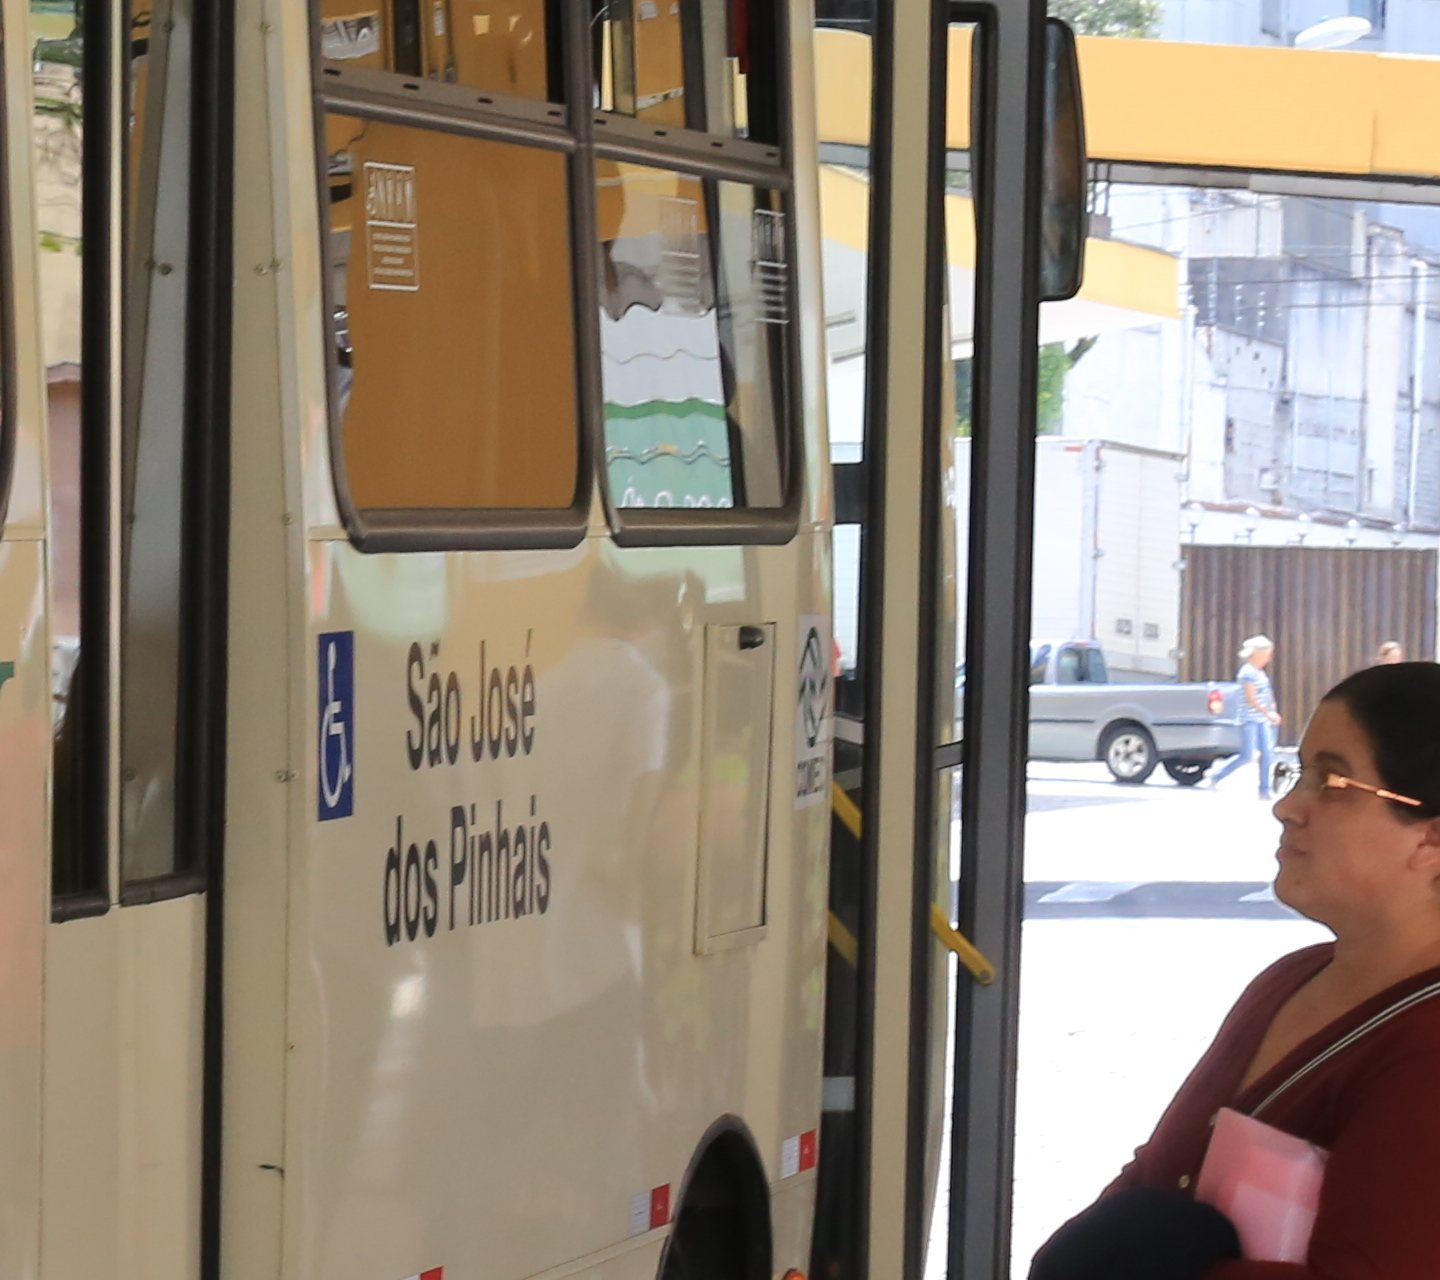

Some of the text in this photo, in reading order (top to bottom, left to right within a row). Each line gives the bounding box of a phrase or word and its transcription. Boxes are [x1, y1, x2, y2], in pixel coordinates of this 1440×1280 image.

[406, 627, 536, 772] São José
[383, 793, 552, 948] dos Pinhais
